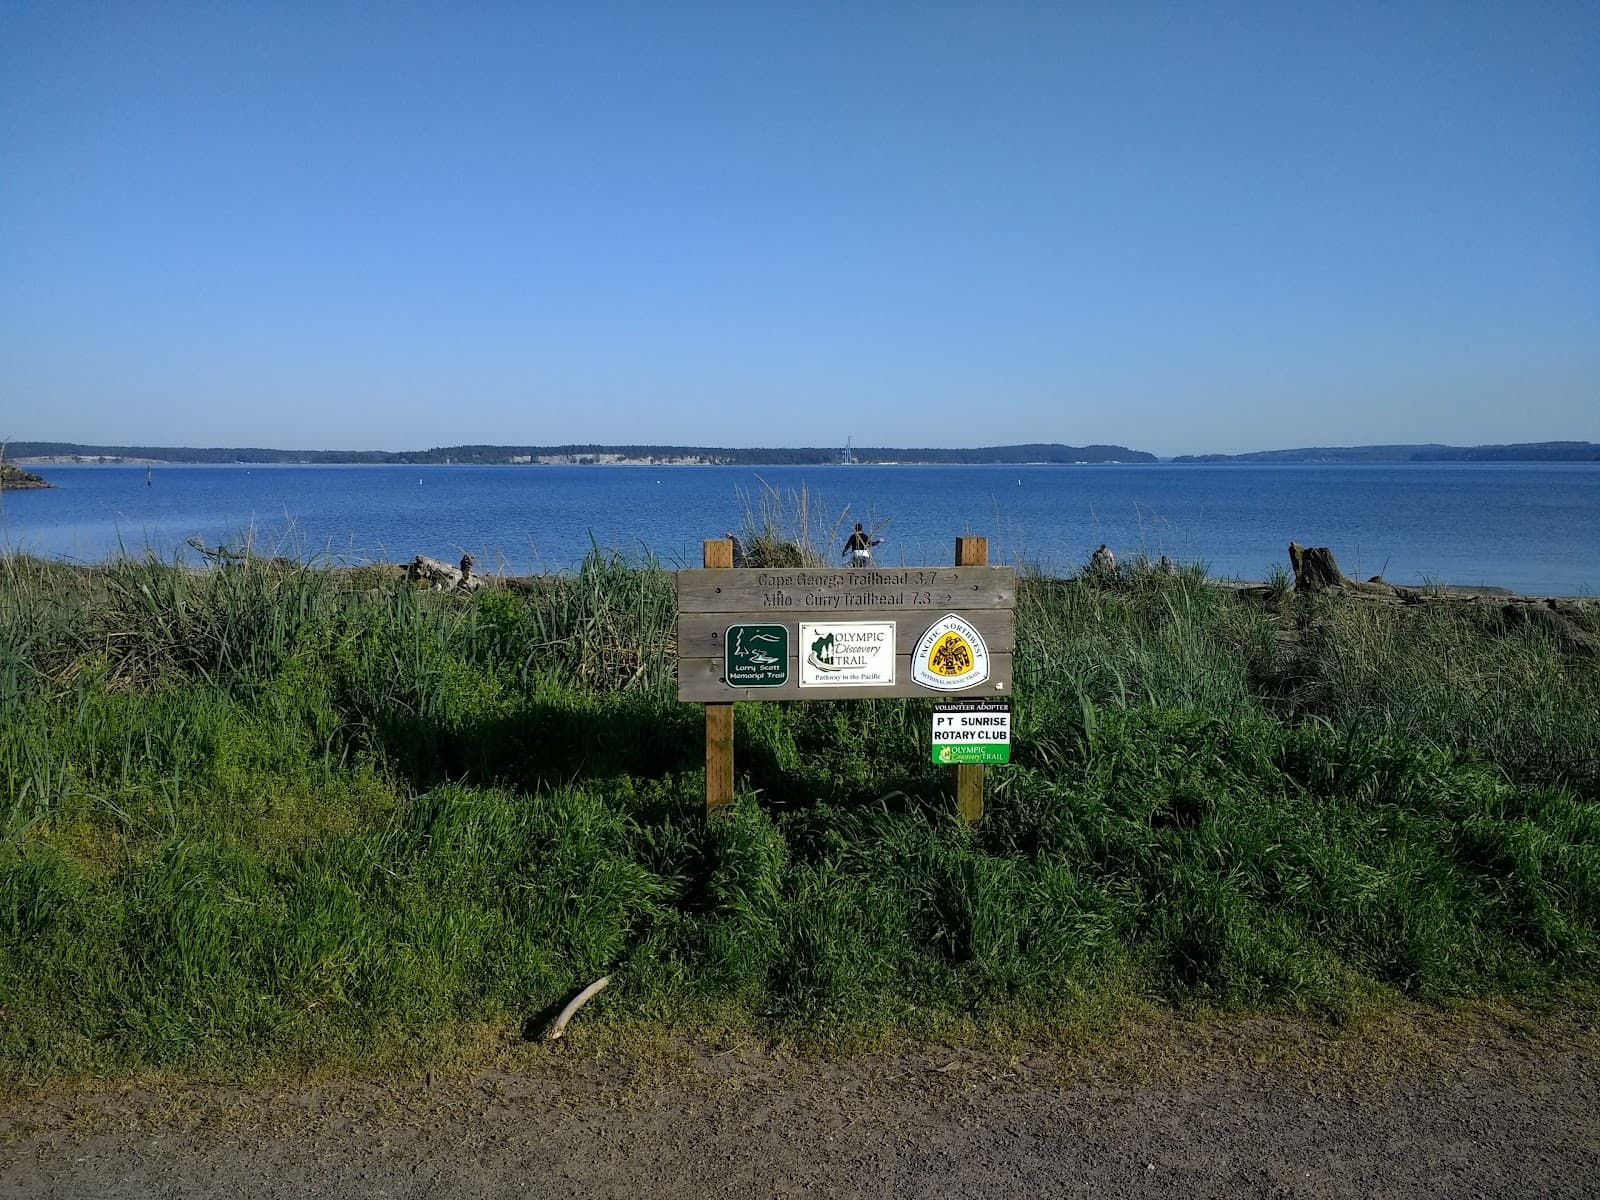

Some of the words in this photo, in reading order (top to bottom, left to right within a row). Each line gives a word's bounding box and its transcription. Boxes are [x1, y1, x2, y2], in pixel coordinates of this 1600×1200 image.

[758, 573, 793, 589] Cape
[796, 572, 844, 590] George
[847, 571, 908, 586] Trailhead
[914, 571, 937, 585] 3.7
[763, 593, 793, 607] Milo
[805, 592, 840, 608] Curry
[843, 592, 904, 606] Trailhead
[911, 591, 932, 605] 7.3
[835, 632, 885, 643] OLYMPIC
[920, 628, 941, 658] PACIFIC
[943, 622, 983, 659] NORTHWEST
[834, 643, 881, 657] Discovery
[835, 656, 868, 666] TRAIL
[730, 671, 764, 680] Memorial
[767, 671, 785, 679] Trail
[961, 717, 1008, 726] SUNRISE
[935, 731, 976, 740] ROTARY
[977, 730, 1007, 740] CLUB
[951, 746, 987, 754] OLYMPIC
